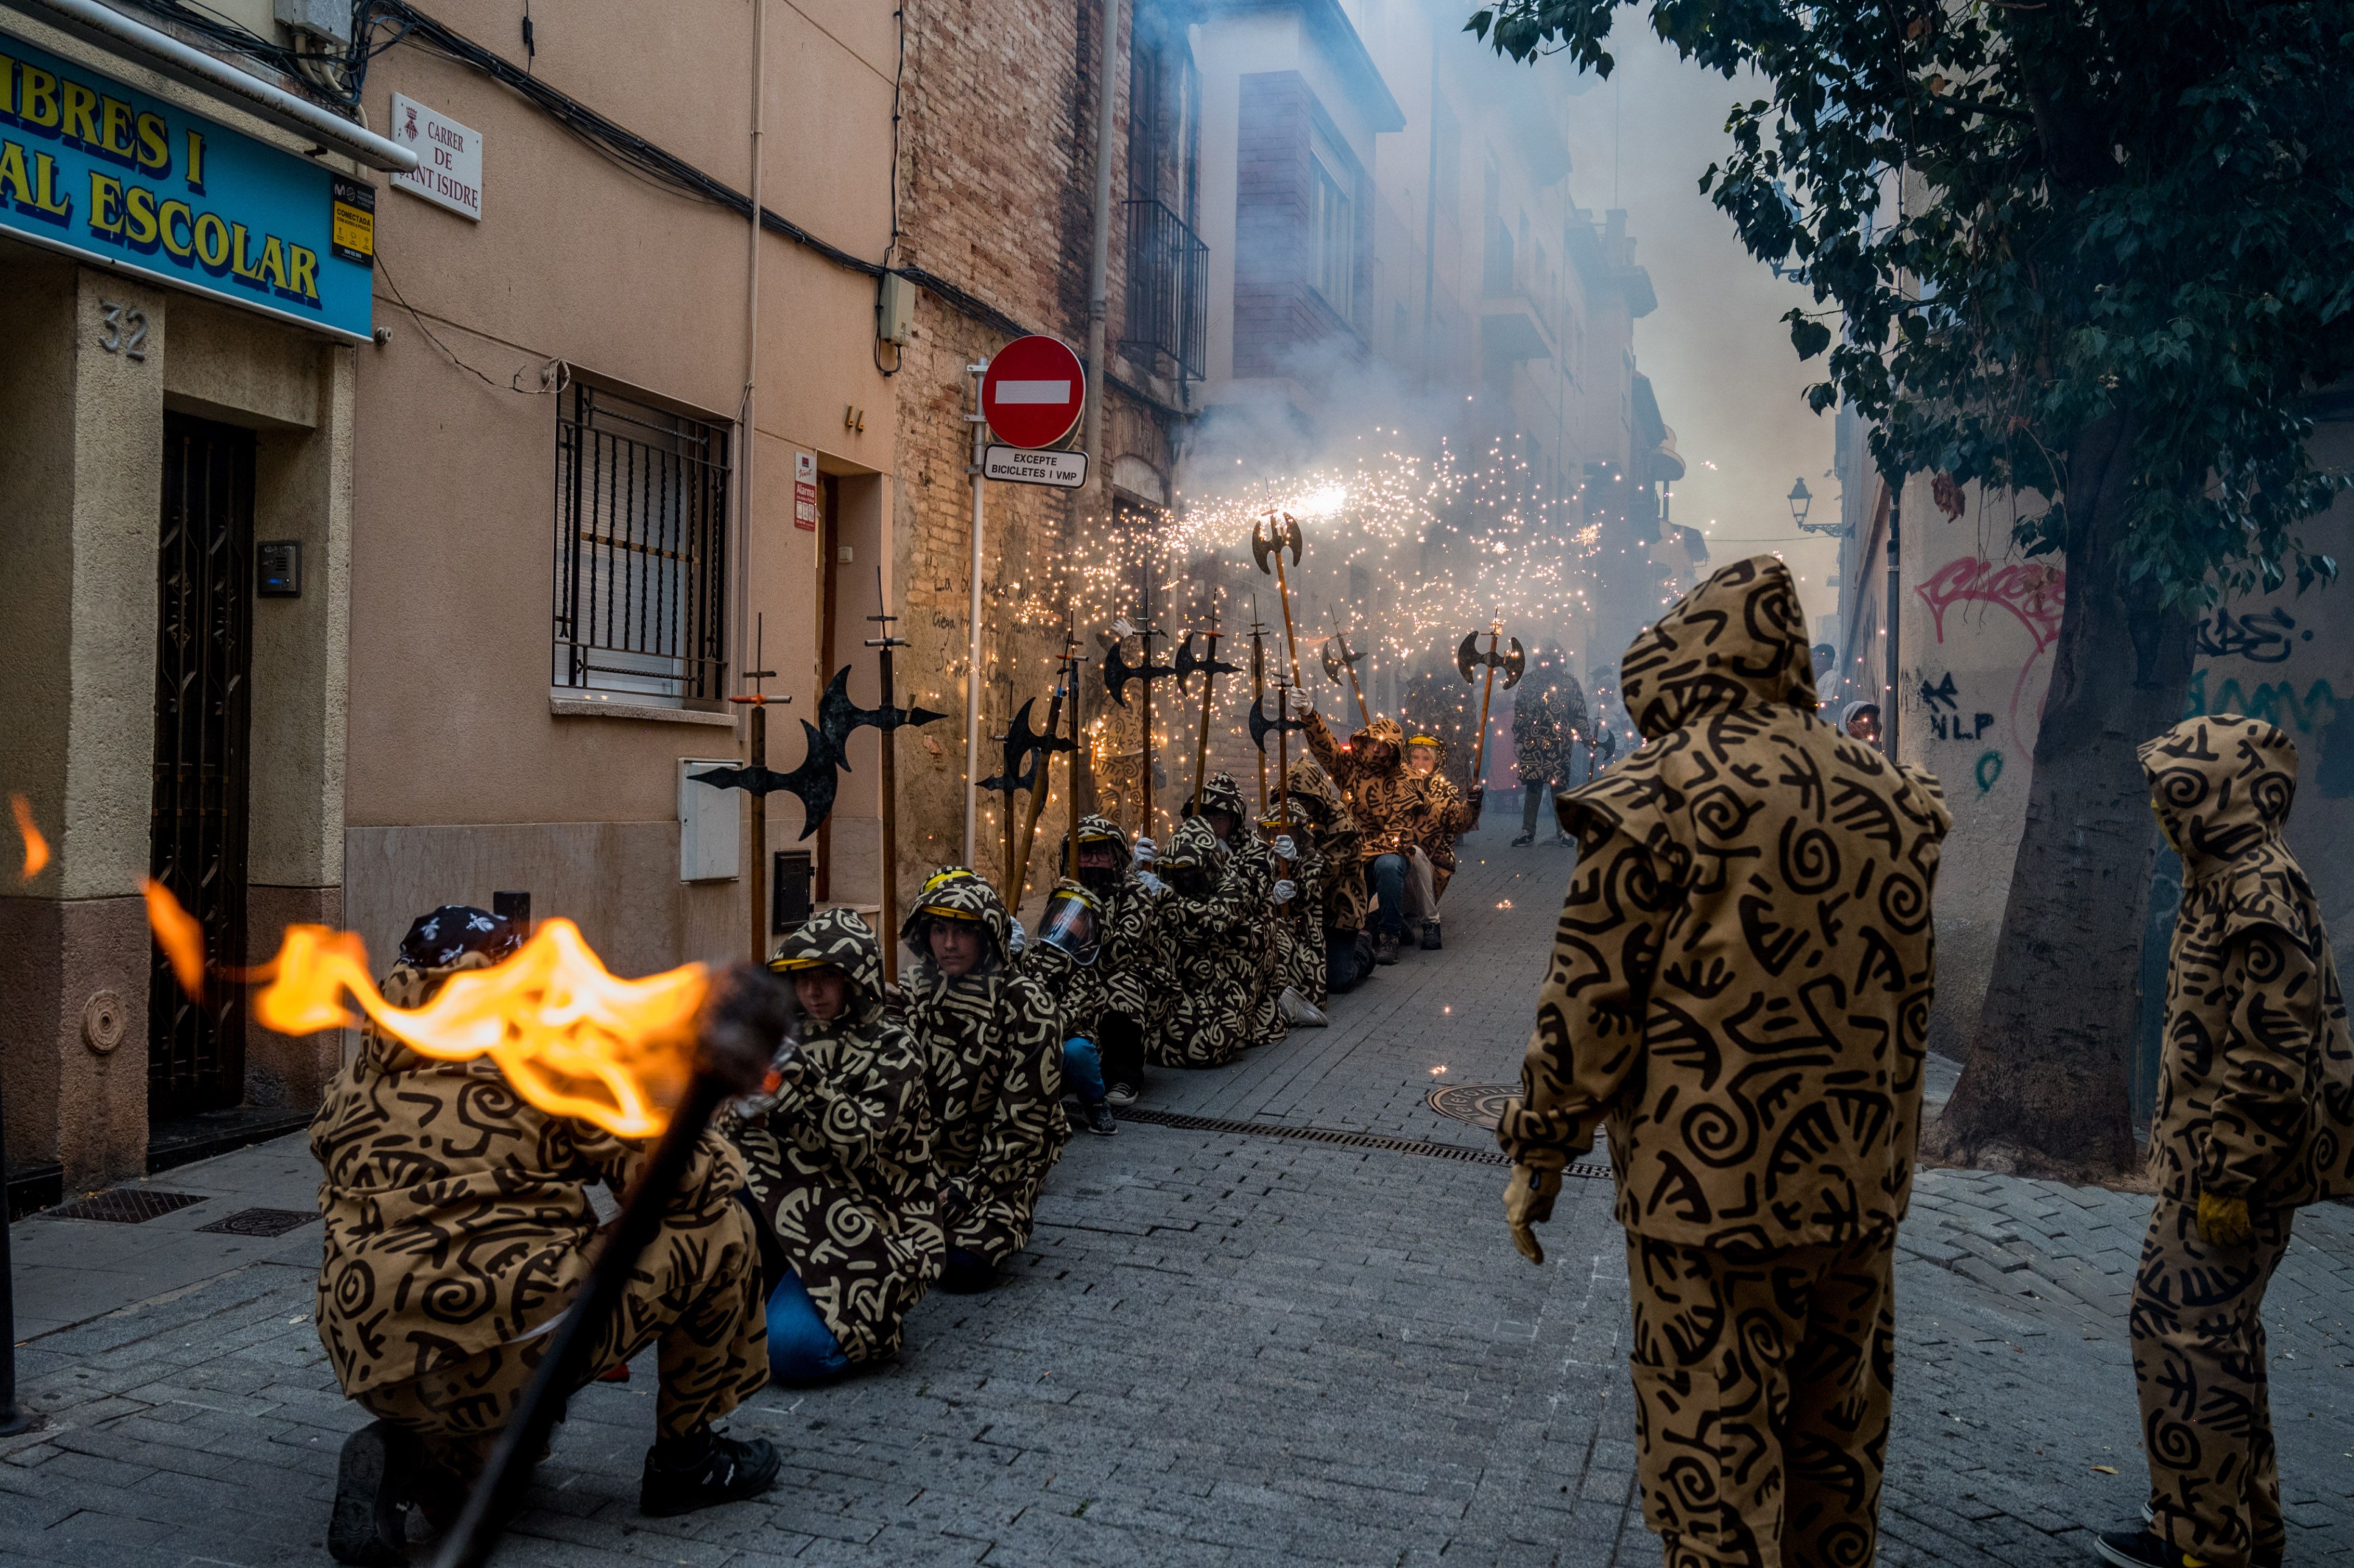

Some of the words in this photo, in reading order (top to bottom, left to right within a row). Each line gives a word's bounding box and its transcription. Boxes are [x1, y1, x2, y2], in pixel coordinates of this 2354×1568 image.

[428, 121, 464, 153] CARRER
[186, 129, 204, 185] I
[434, 147, 452, 171] DE
[399, 164, 434, 189] NT
[437, 173, 478, 208] ISIDRE
[337, 208, 371, 227] CONECTADA
[88, 171, 319, 299] ESCOLAR
[99, 299, 148, 362] 32
[1014, 453, 1057, 466] EXCEPTE
[799, 468, 812, 478] Direct
[991, 464, 1045, 478] BICICLETES
[1050, 470, 1052, 478] I
[1056, 471, 1077, 481] VMP
[796, 484, 815, 498] Alarma
